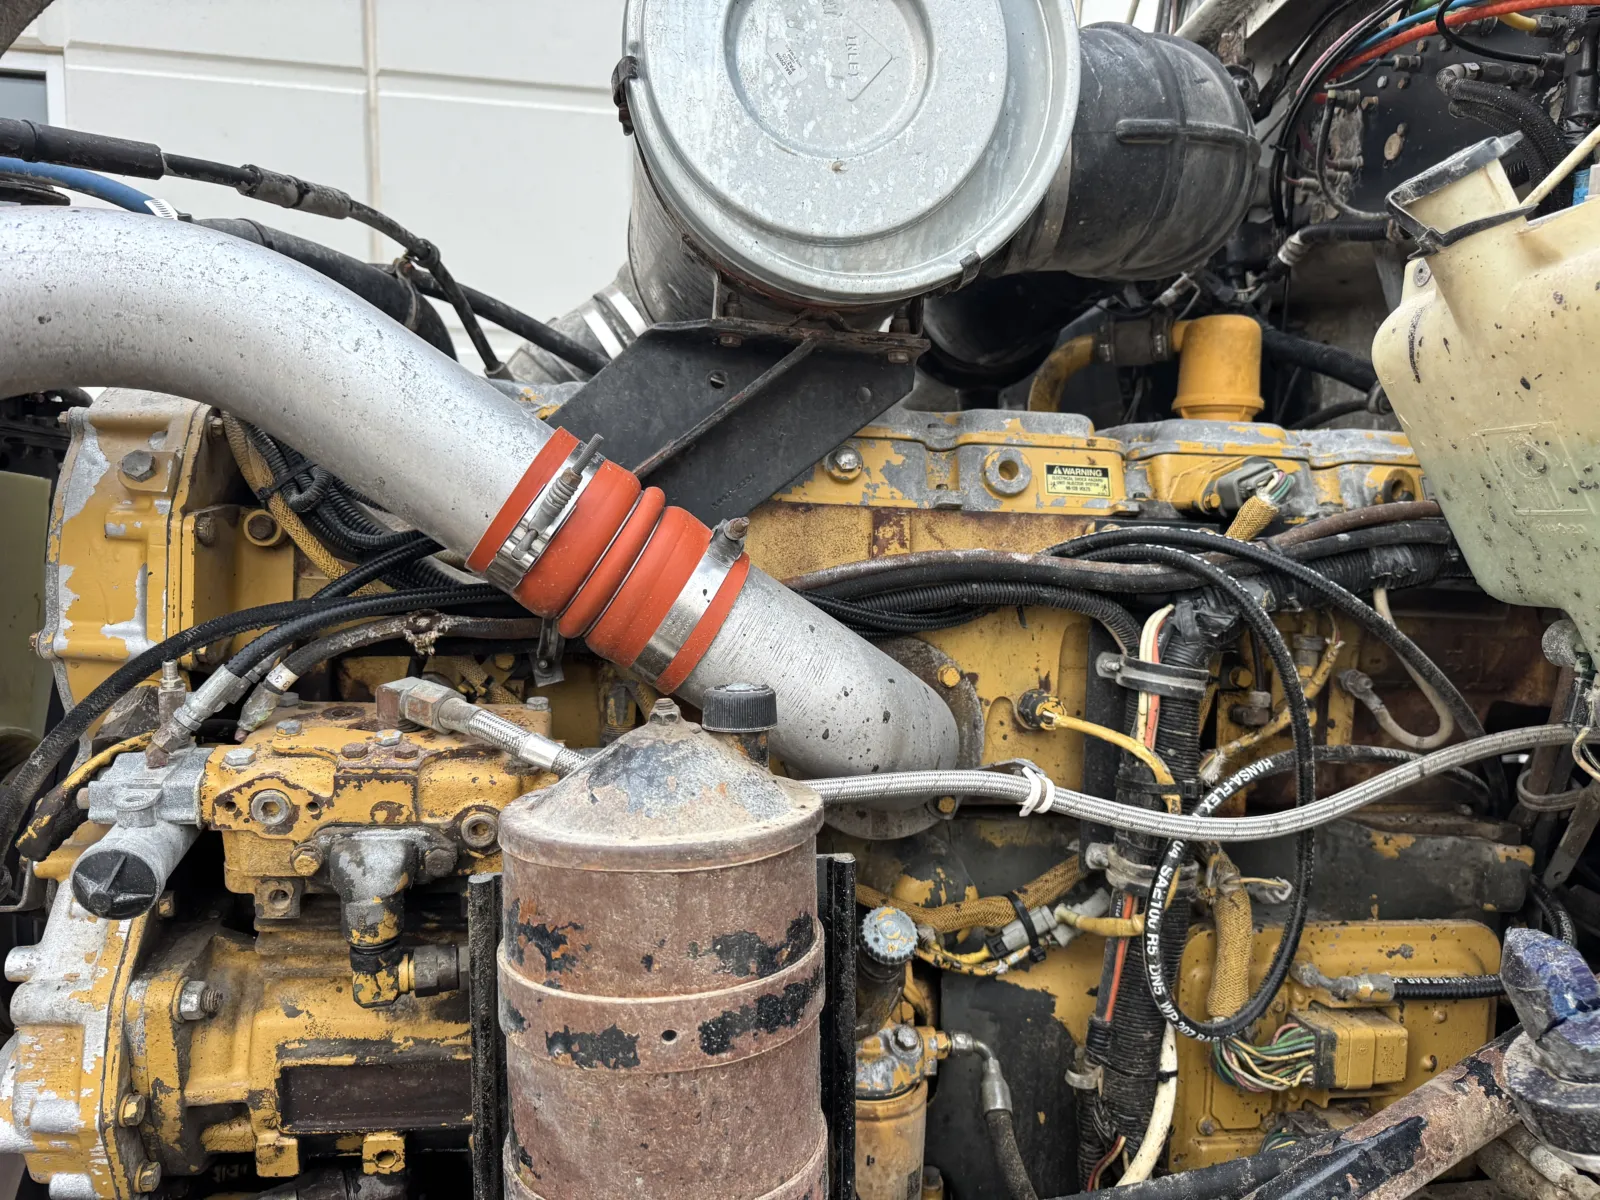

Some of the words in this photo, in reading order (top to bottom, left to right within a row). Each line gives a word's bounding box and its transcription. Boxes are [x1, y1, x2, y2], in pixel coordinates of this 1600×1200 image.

[774, 52, 792, 75] BALDWIN
[1061, 467, 1102, 476] WARNING
[1203, 758, 1275, 815] HANSA-FLEX
[1557, 910, 1573, 946] HANSA-FLE
[1146, 932, 1160, 955] R5
[1149, 960, 1166, 996] DN5
[1405, 976, 1429, 984] BAR
[1160, 1000, 1179, 1023] WP
[1177, 1020, 1196, 1037] 207
